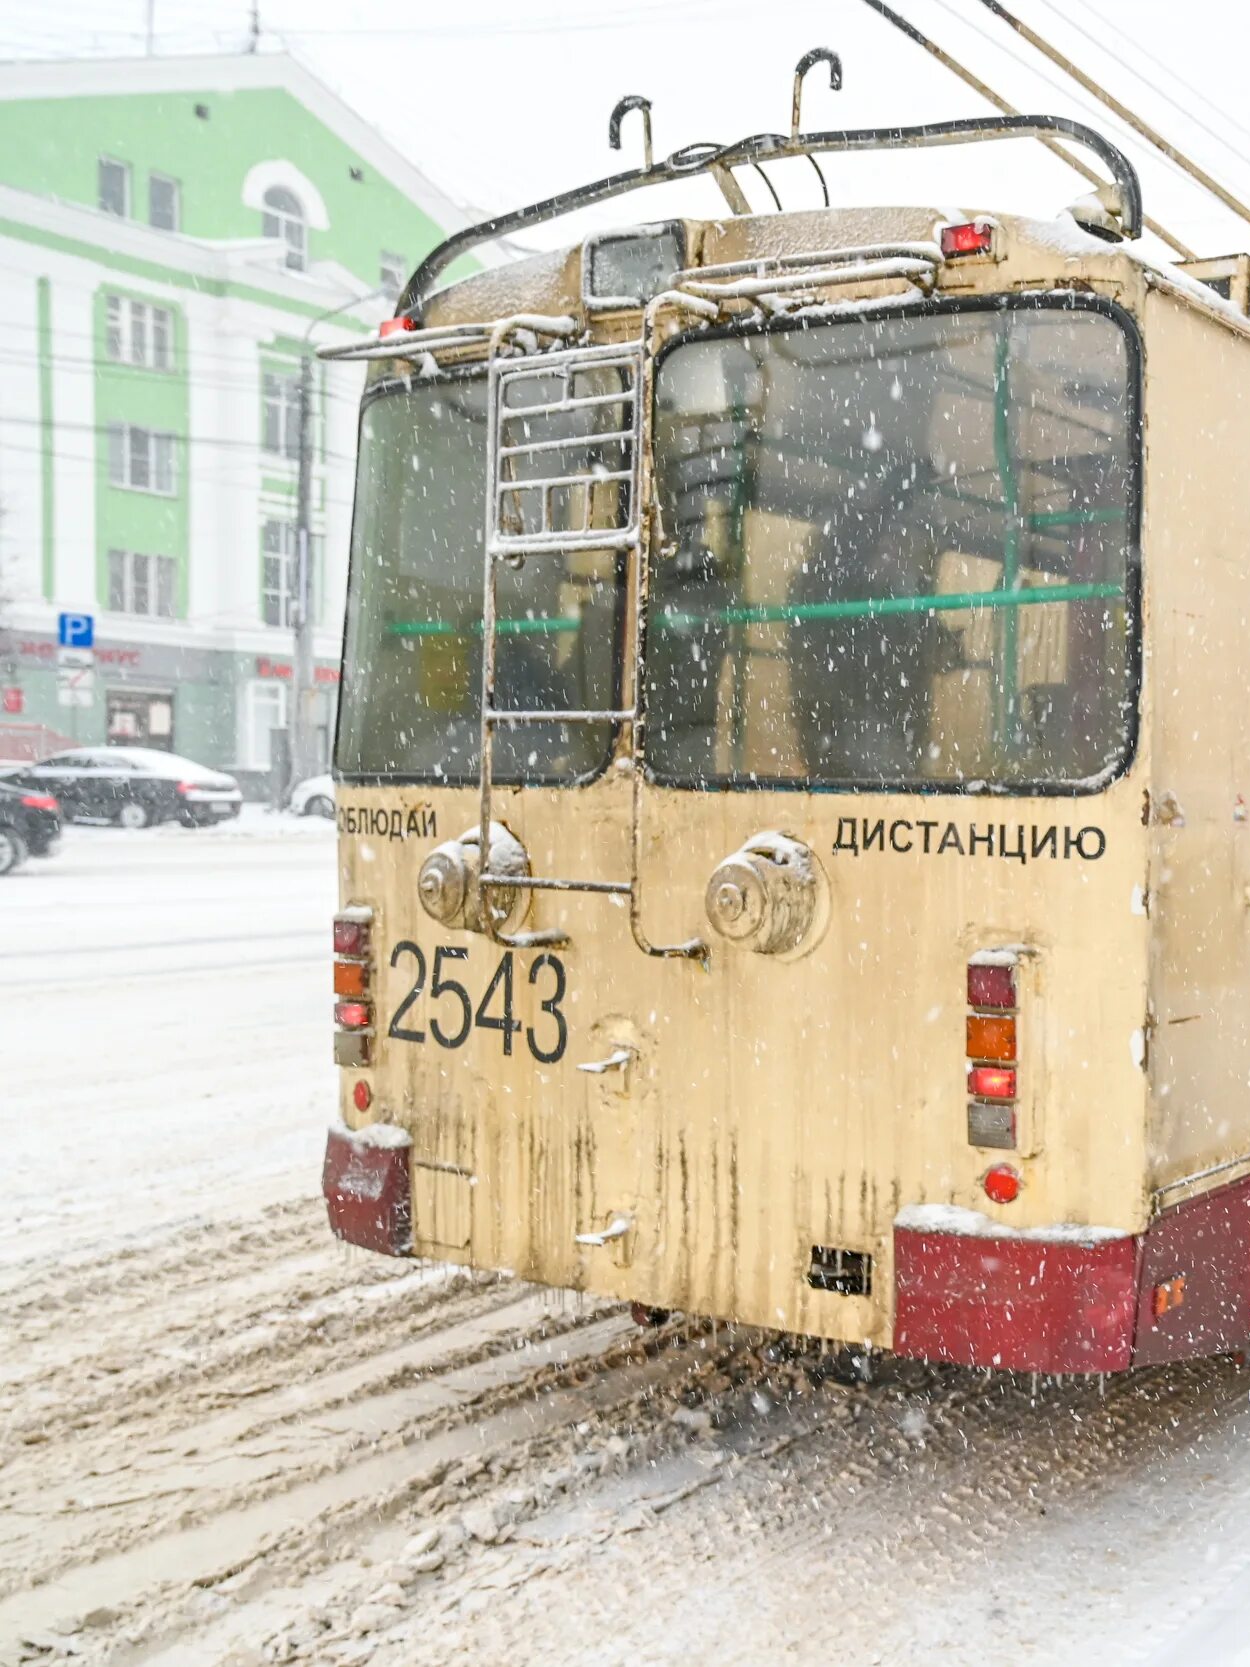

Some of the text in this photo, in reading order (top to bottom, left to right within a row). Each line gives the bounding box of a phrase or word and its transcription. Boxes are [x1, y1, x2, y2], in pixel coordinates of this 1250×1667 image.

[65, 615, 88, 645] P
[832, 817, 1106, 865] ДИСТАНЦИЮ
[388, 940, 567, 1064] 2543
